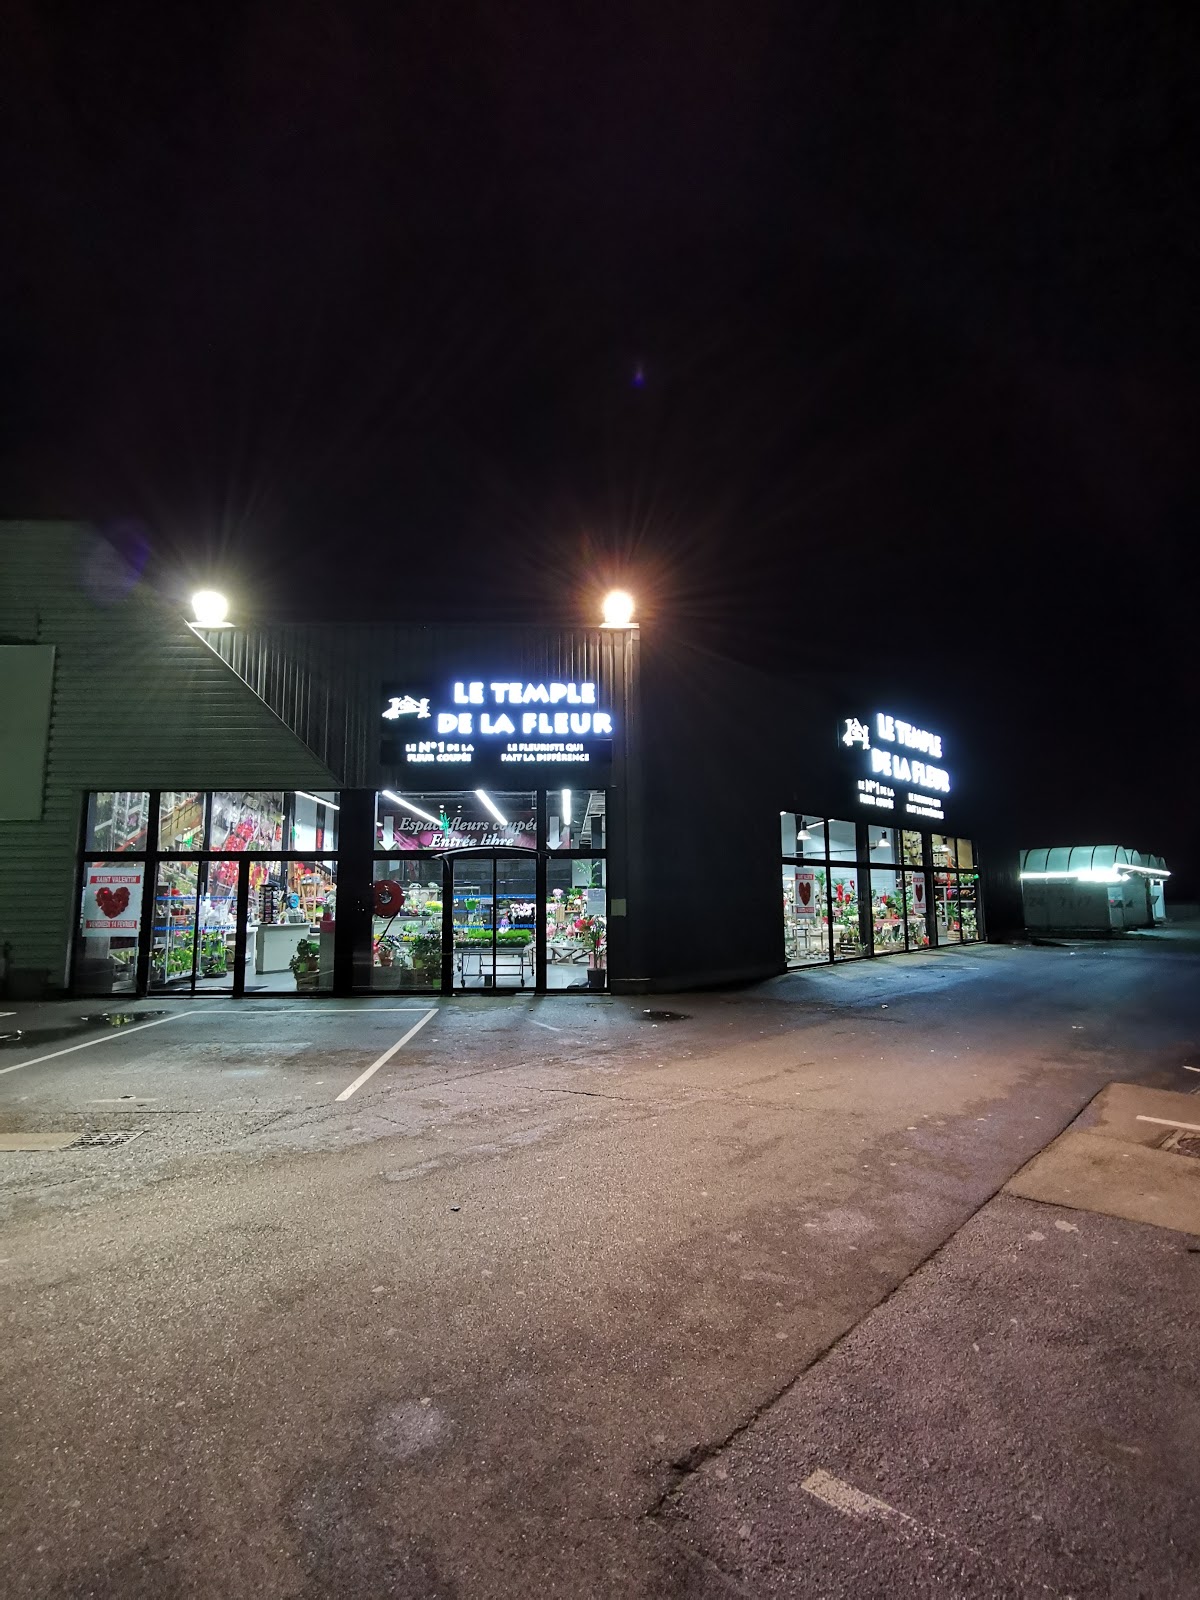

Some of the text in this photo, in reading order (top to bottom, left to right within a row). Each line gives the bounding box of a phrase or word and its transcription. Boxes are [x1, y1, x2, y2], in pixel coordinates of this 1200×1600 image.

[454, 682, 596, 704] LE TEMPLE
[437, 713, 613, 734] DE LA FLEUR
[877, 712, 943, 758] LE TEMPLE
[405, 743, 417, 752] LE
[447, 743, 460, 752] DE
[461, 743, 475, 752] LA
[507, 743, 584, 752] LE FLEURISTE QUI
[407, 752, 472, 762] FLEUR COUPÉE
[501, 752, 590, 762] FAIT LA DIFFÉRENCE
[871, 747, 951, 793] DE LA FLEUR
[447, 817, 489, 835] fleurs
[429, 833, 515, 847] Entrée libre
